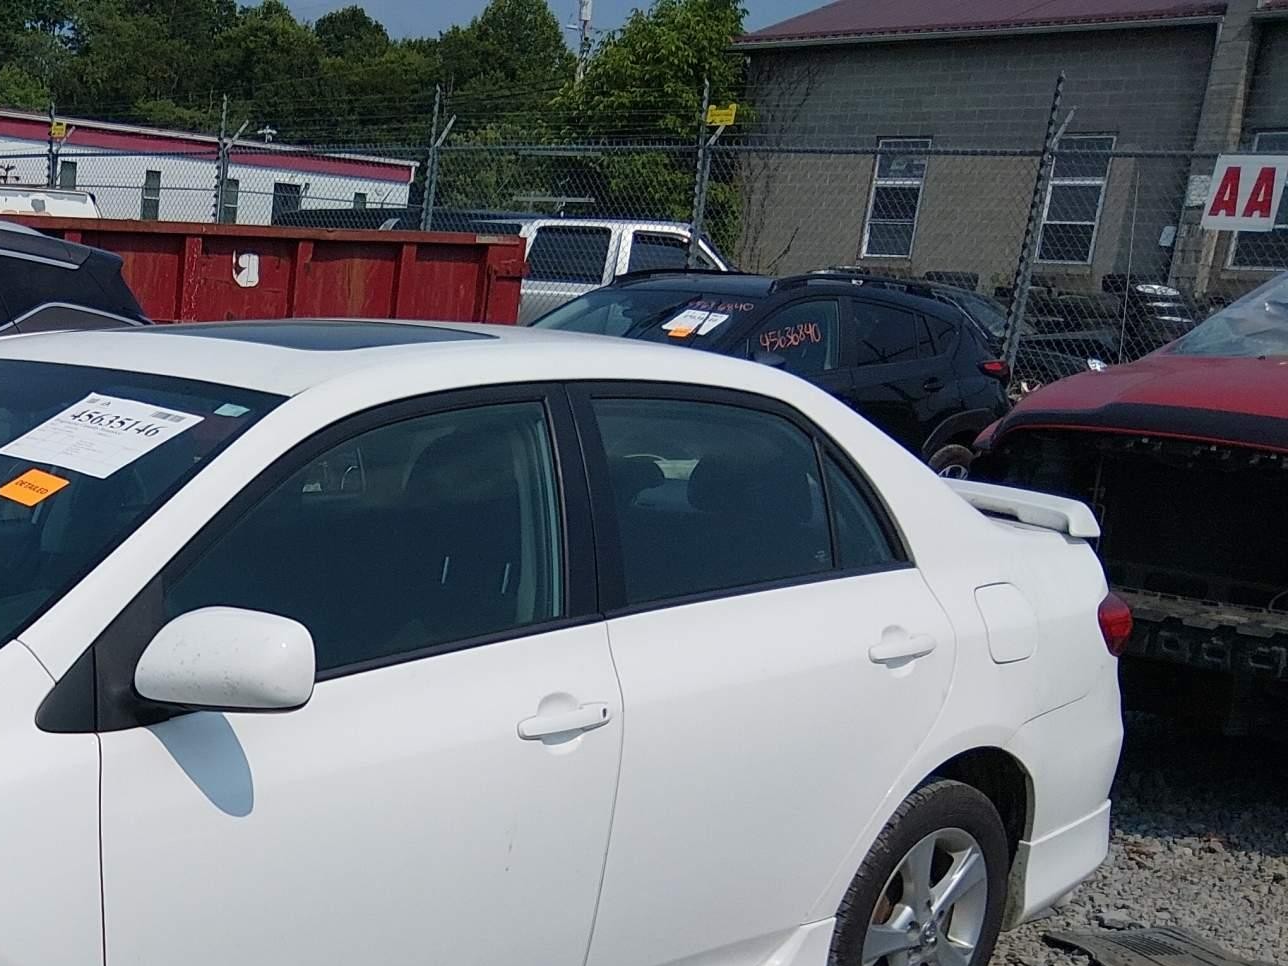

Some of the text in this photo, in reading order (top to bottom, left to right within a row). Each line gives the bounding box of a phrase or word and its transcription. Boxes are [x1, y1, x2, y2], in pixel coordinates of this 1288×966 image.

[1208, 166, 1277, 218] AA
[759, 322, 822, 352] 45636840
[70, 409, 167, 438] 45635146
[14, 478, 50, 496] DETAILED
